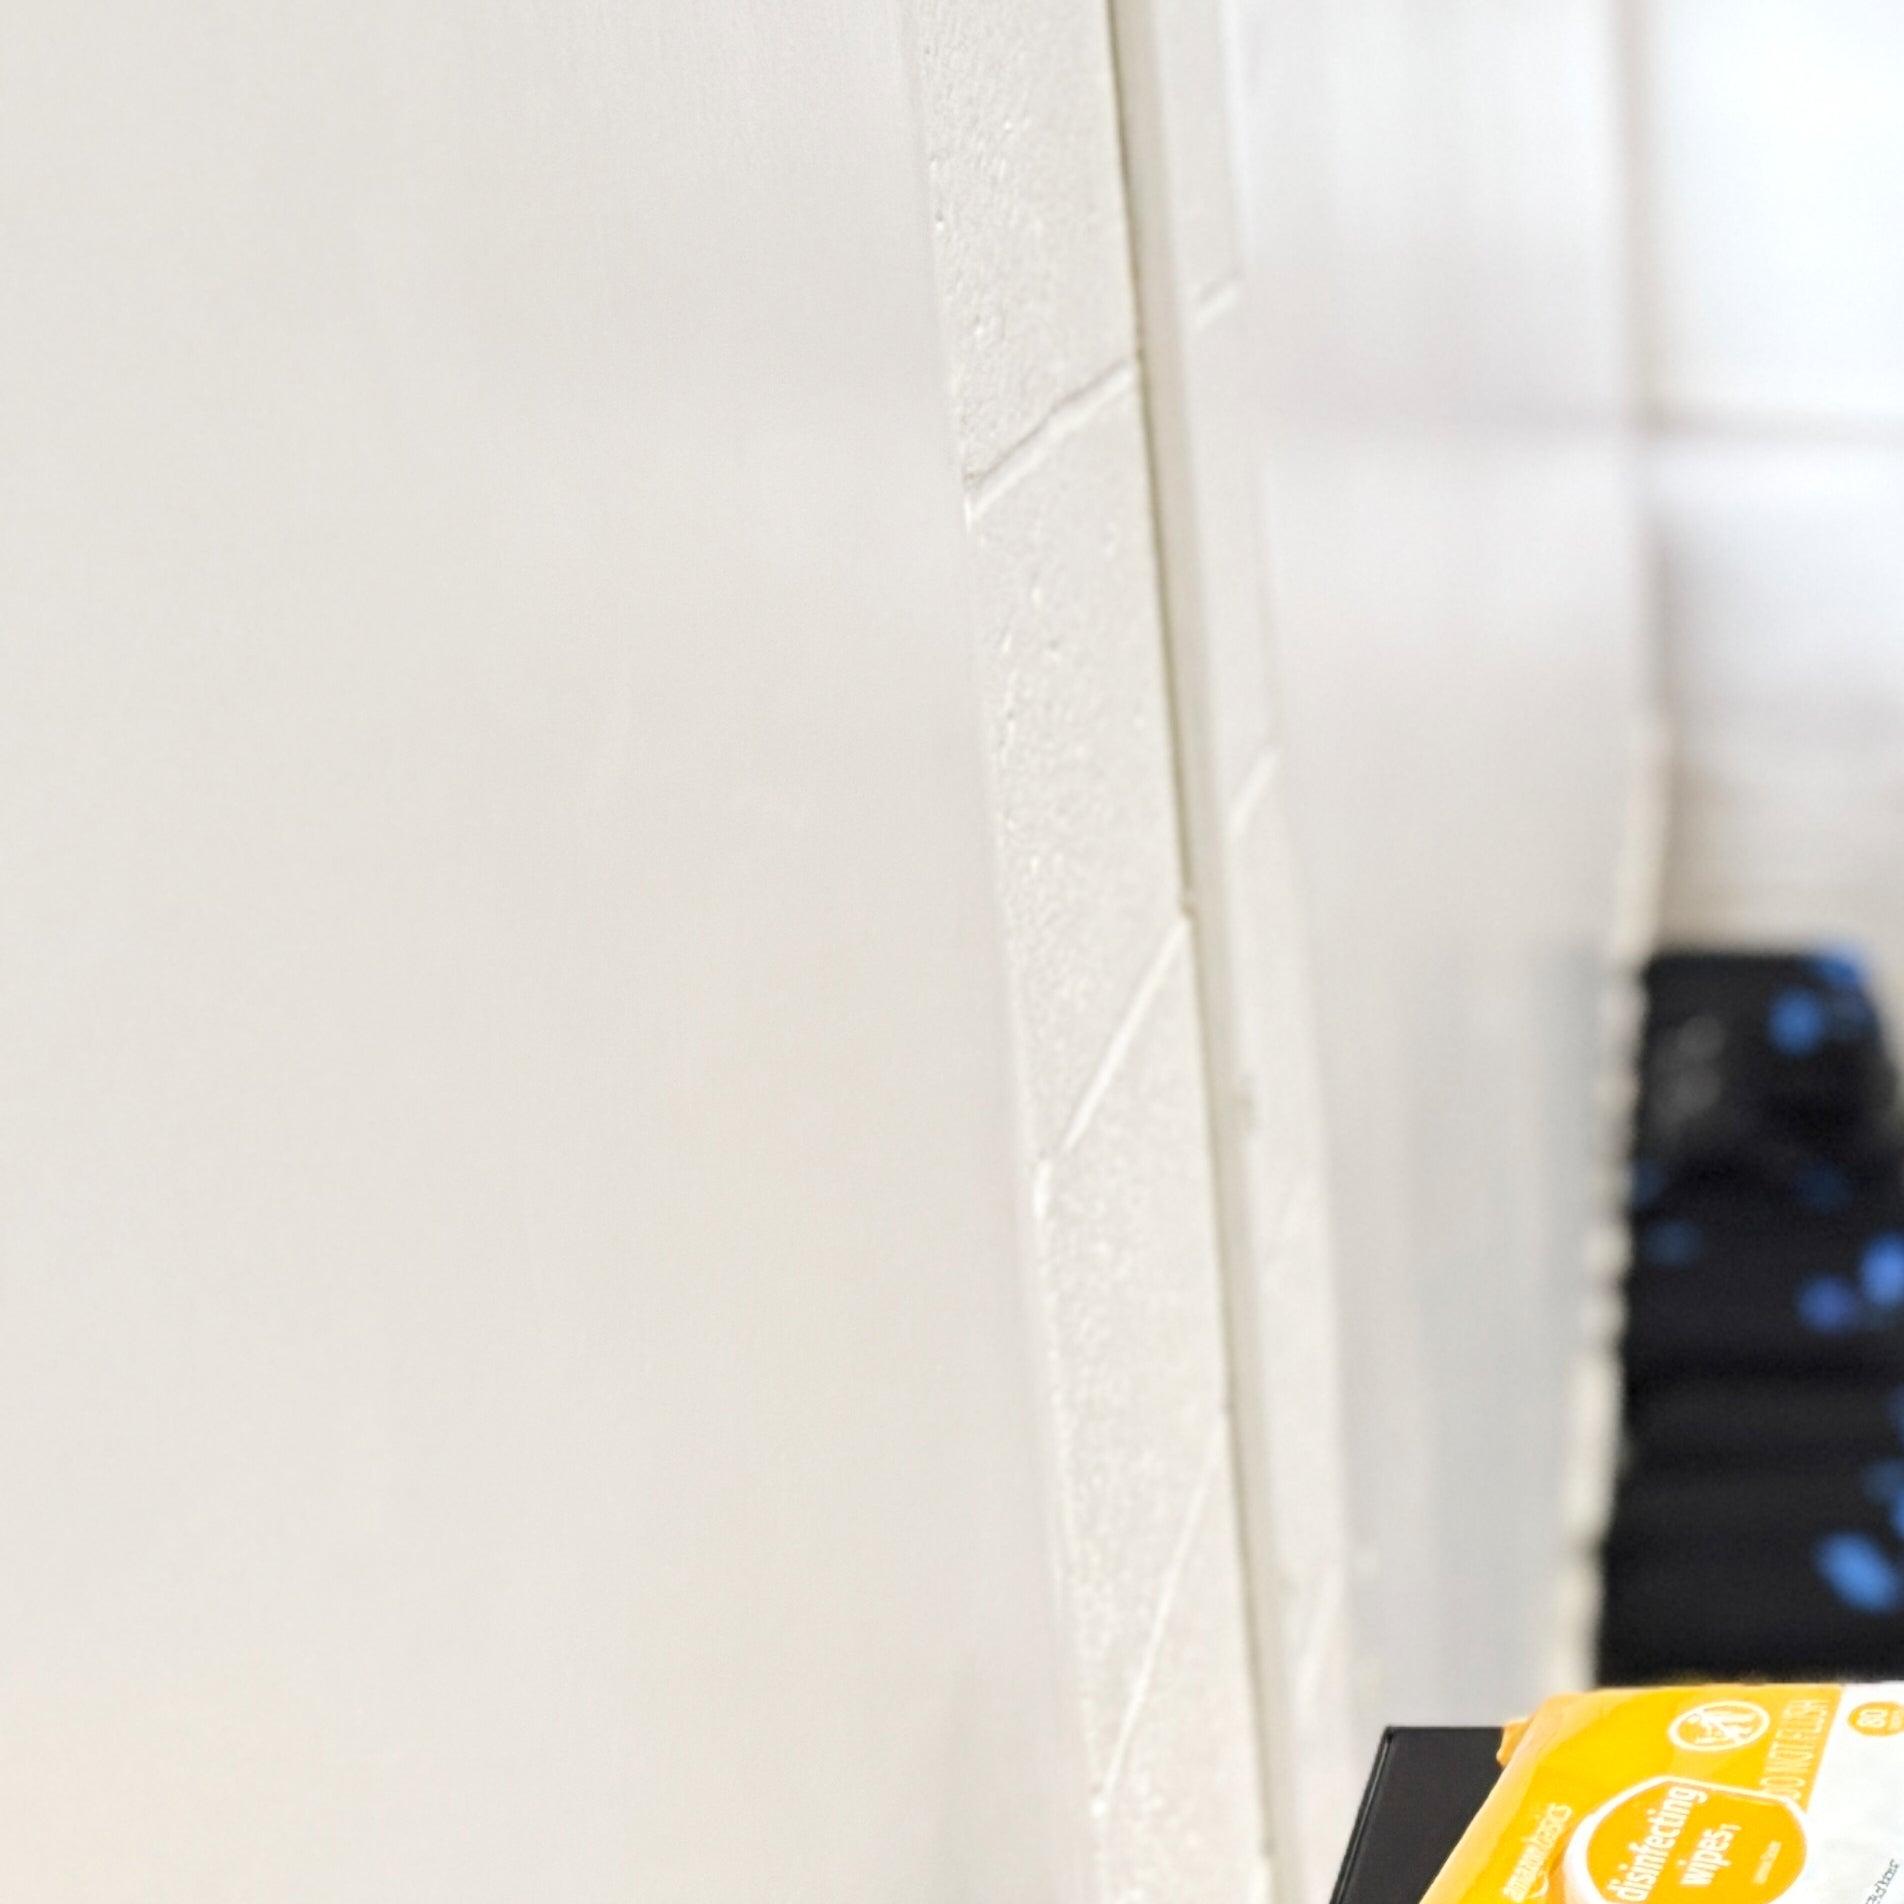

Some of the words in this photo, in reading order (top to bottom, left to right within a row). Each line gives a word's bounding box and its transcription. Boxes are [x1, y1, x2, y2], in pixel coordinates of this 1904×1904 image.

[1775, 1700, 1829, 1741] FLUSH
[1763, 1741, 1814, 1774] NOT
[1607, 1785, 1708, 1902] disinfecting
